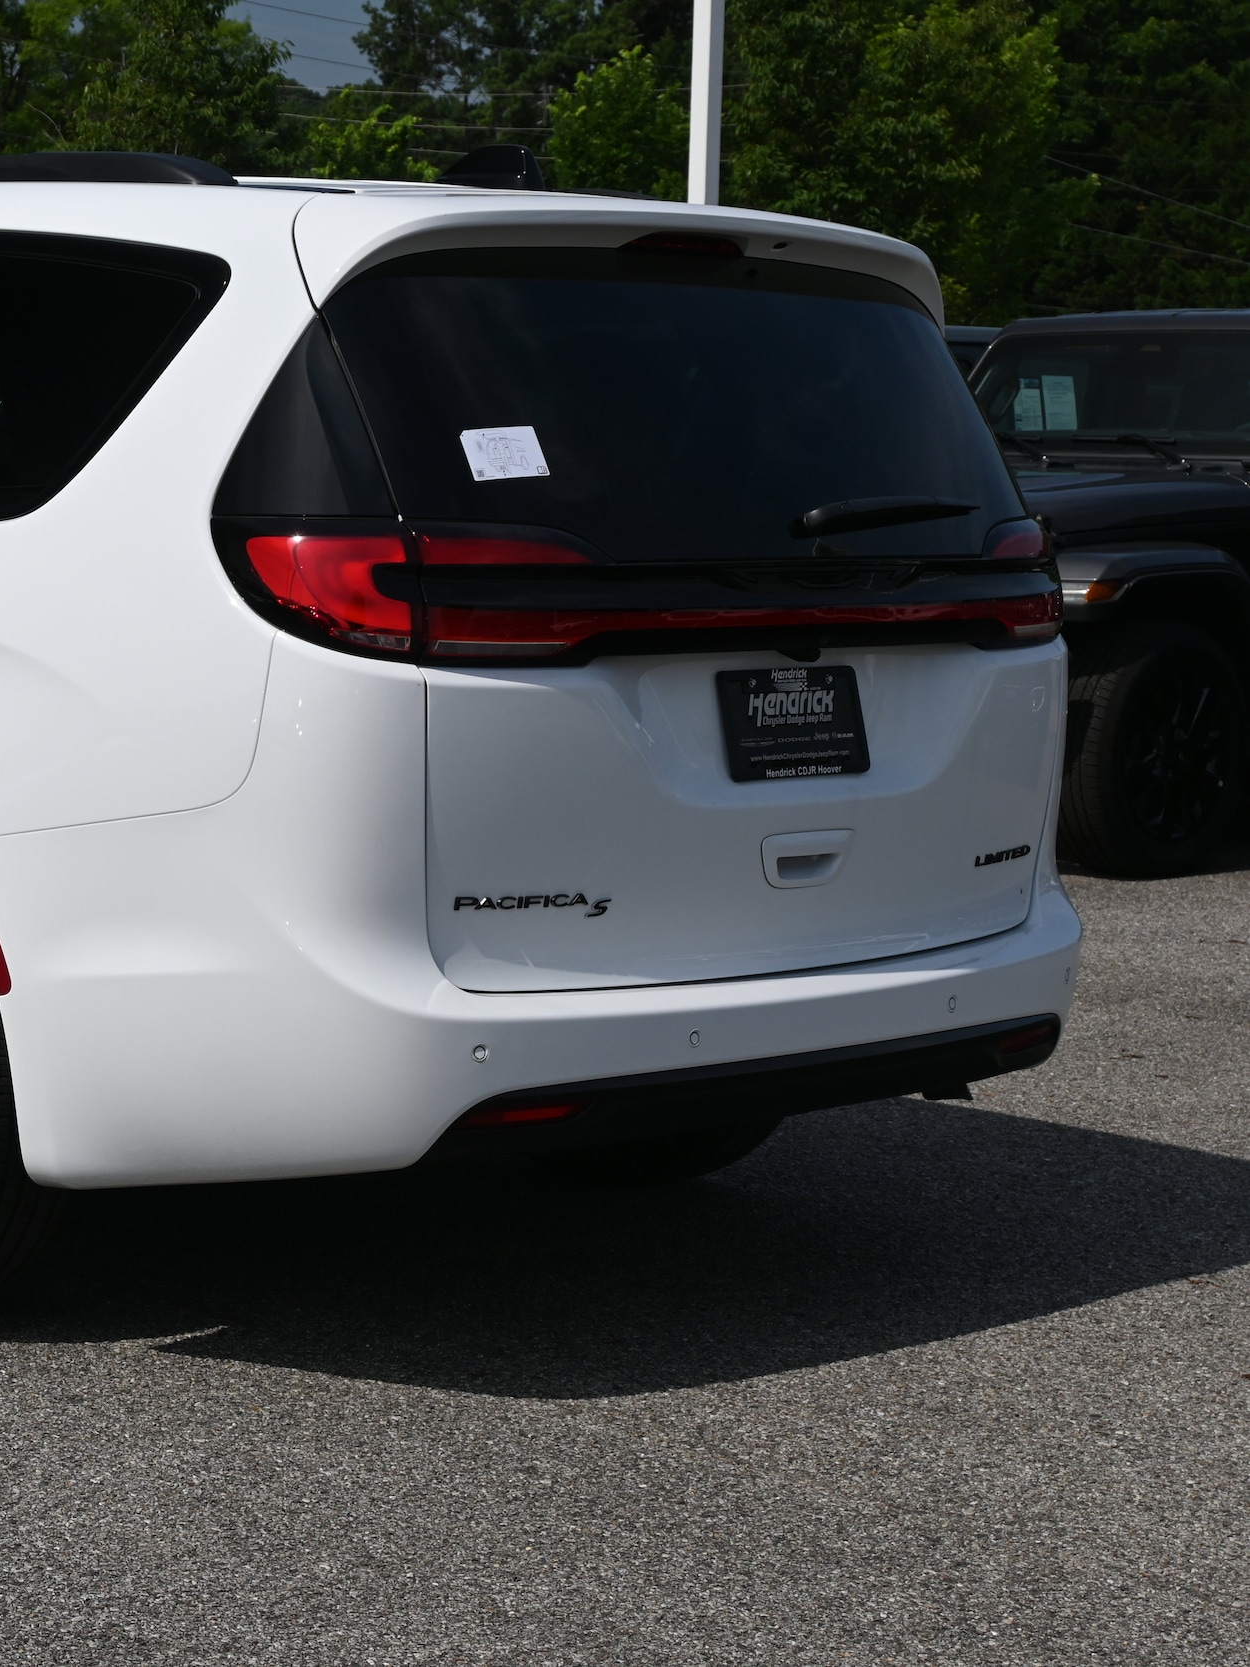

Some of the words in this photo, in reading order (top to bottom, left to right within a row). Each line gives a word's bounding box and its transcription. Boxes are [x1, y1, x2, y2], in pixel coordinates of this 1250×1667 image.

[771, 668, 808, 683] Hendrick
[748, 689, 835, 728] Hendrick
[763, 715, 786, 727] Chrysler
[787, 714, 805, 726] Dodge
[805, 713, 819, 724] Jeep
[819, 713, 833, 722] Ram
[813, 732, 830, 741] Jeep
[766, 767, 796, 778] Hendrick
[797, 765, 817, 776] CDJR
[818, 765, 842, 775] Hoover
[975, 844, 1031, 867] LIMITED
[453, 893, 588, 911] PACIFICA
[584, 899, 612, 918] S
